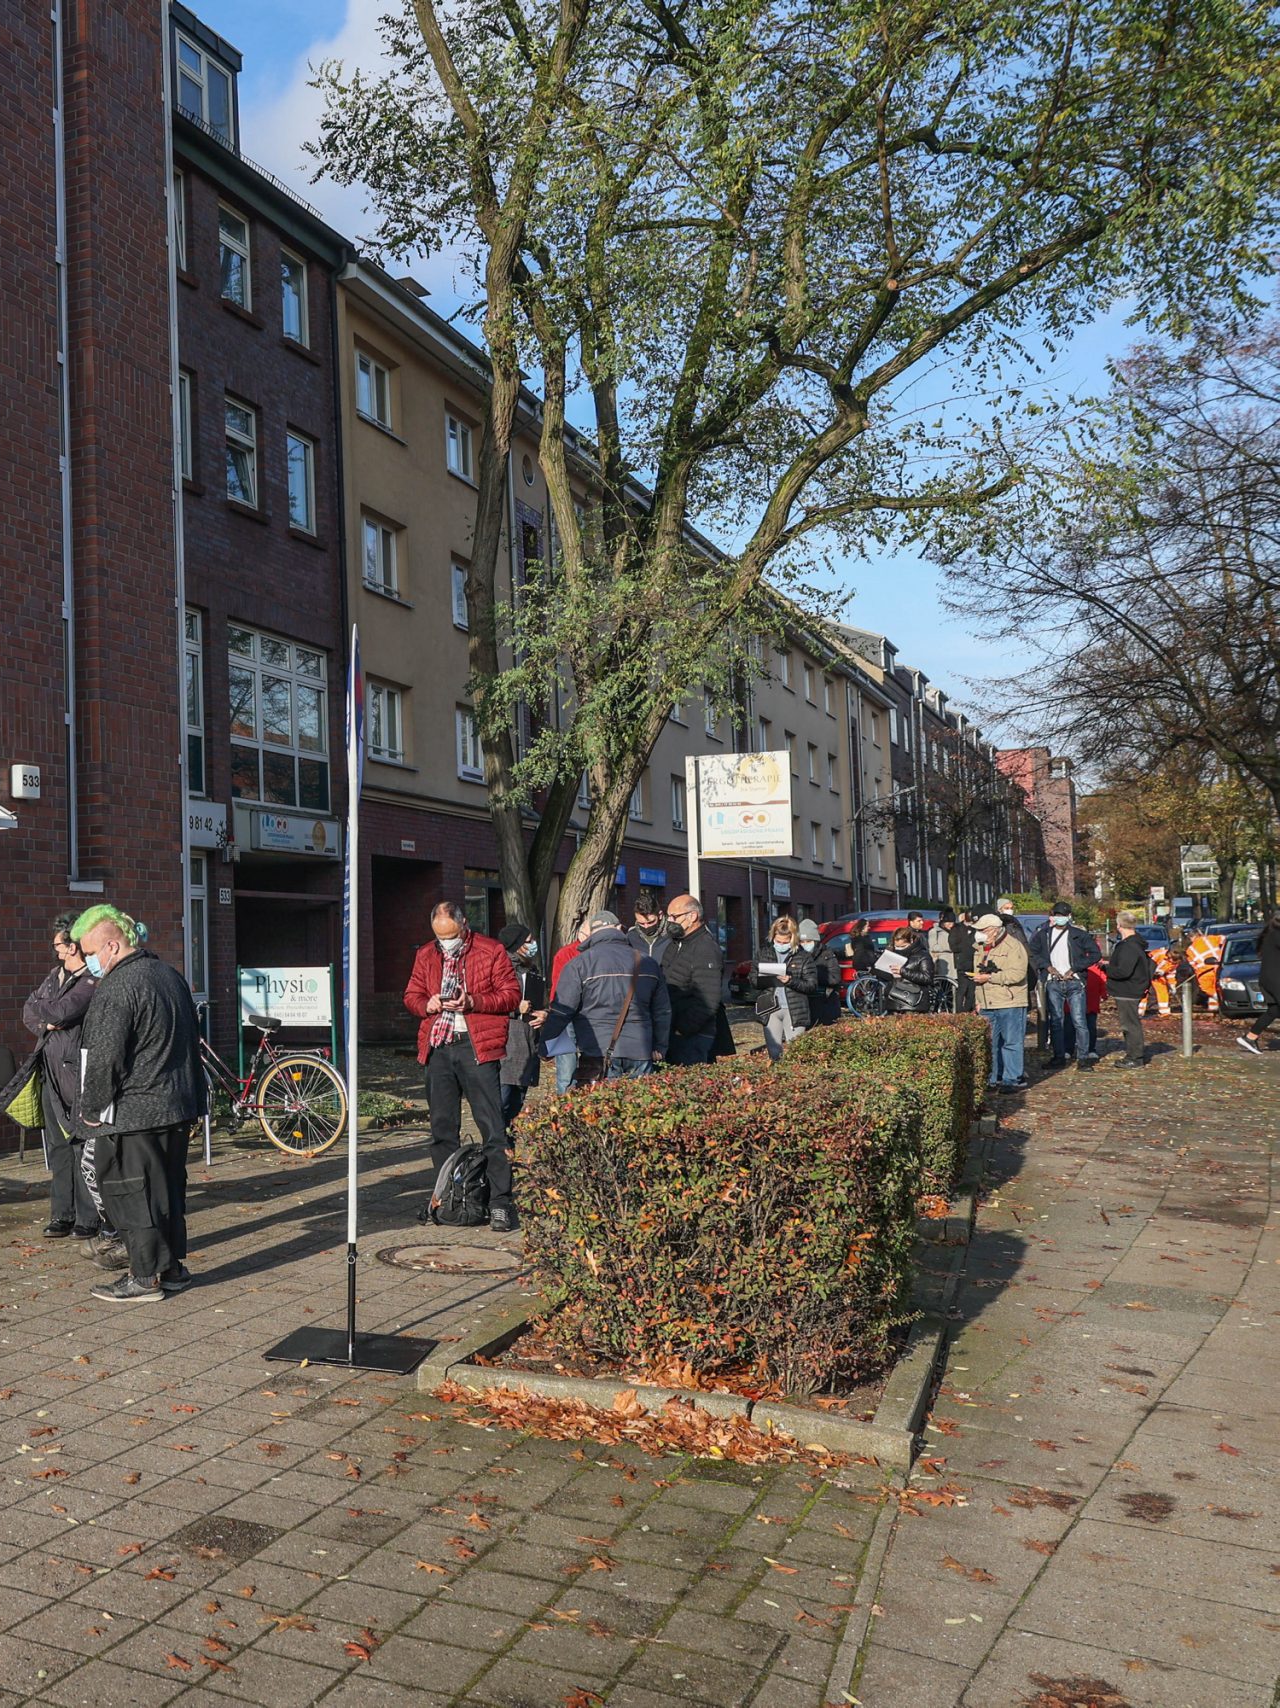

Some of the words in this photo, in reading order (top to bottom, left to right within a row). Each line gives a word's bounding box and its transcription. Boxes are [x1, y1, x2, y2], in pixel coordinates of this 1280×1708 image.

[22, 774, 40, 788] 533
[220, 889, 230, 900] 533
[255, 974, 318, 998] Physio
